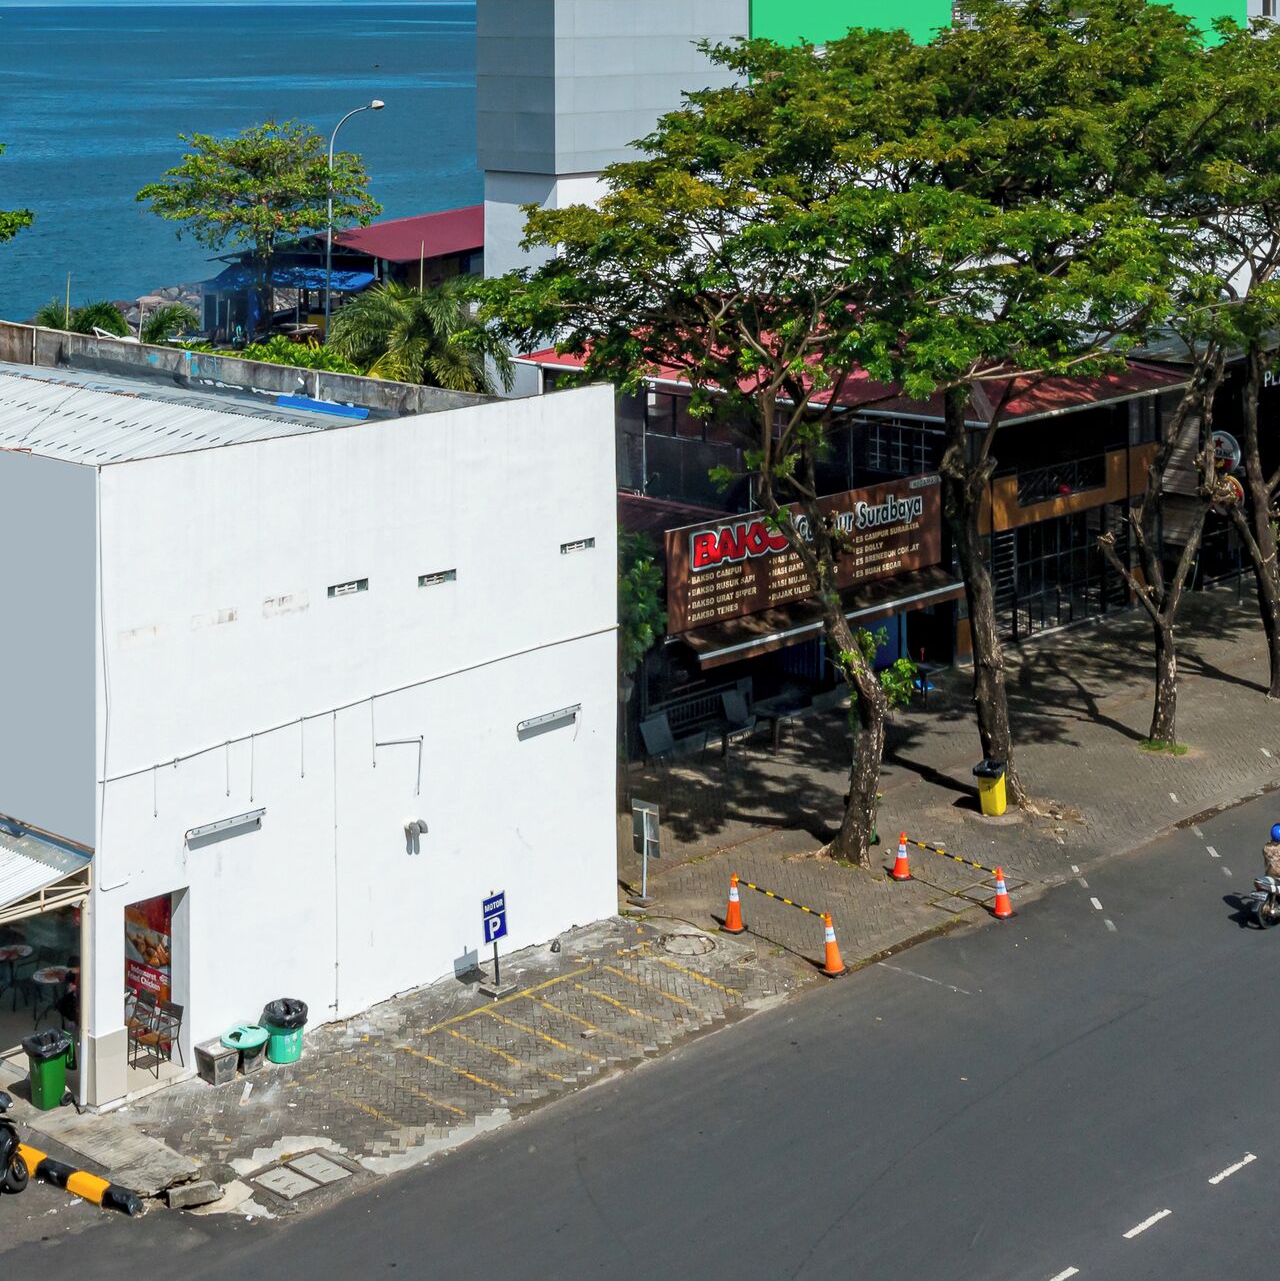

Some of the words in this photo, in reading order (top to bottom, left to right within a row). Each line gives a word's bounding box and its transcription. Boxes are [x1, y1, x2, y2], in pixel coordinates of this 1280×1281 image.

[856, 494, 922, 529] Surabaya
[864, 529, 889, 541] CAMPUR
[772, 554, 788, 565] NASI
[771, 566, 788, 577] NASI
[855, 570, 864, 578] ES
[691, 572, 715, 585] BAKSO
[691, 584, 715, 597] BAKSO
[716, 578, 739, 590] RUSUK
[691, 597, 715, 609] BAKSO
[691, 609, 715, 622] BAKSO
[484, 898, 504, 913] MOTOR
[489, 916, 501, 940] P
[140, 976, 161, 991] Chicken
